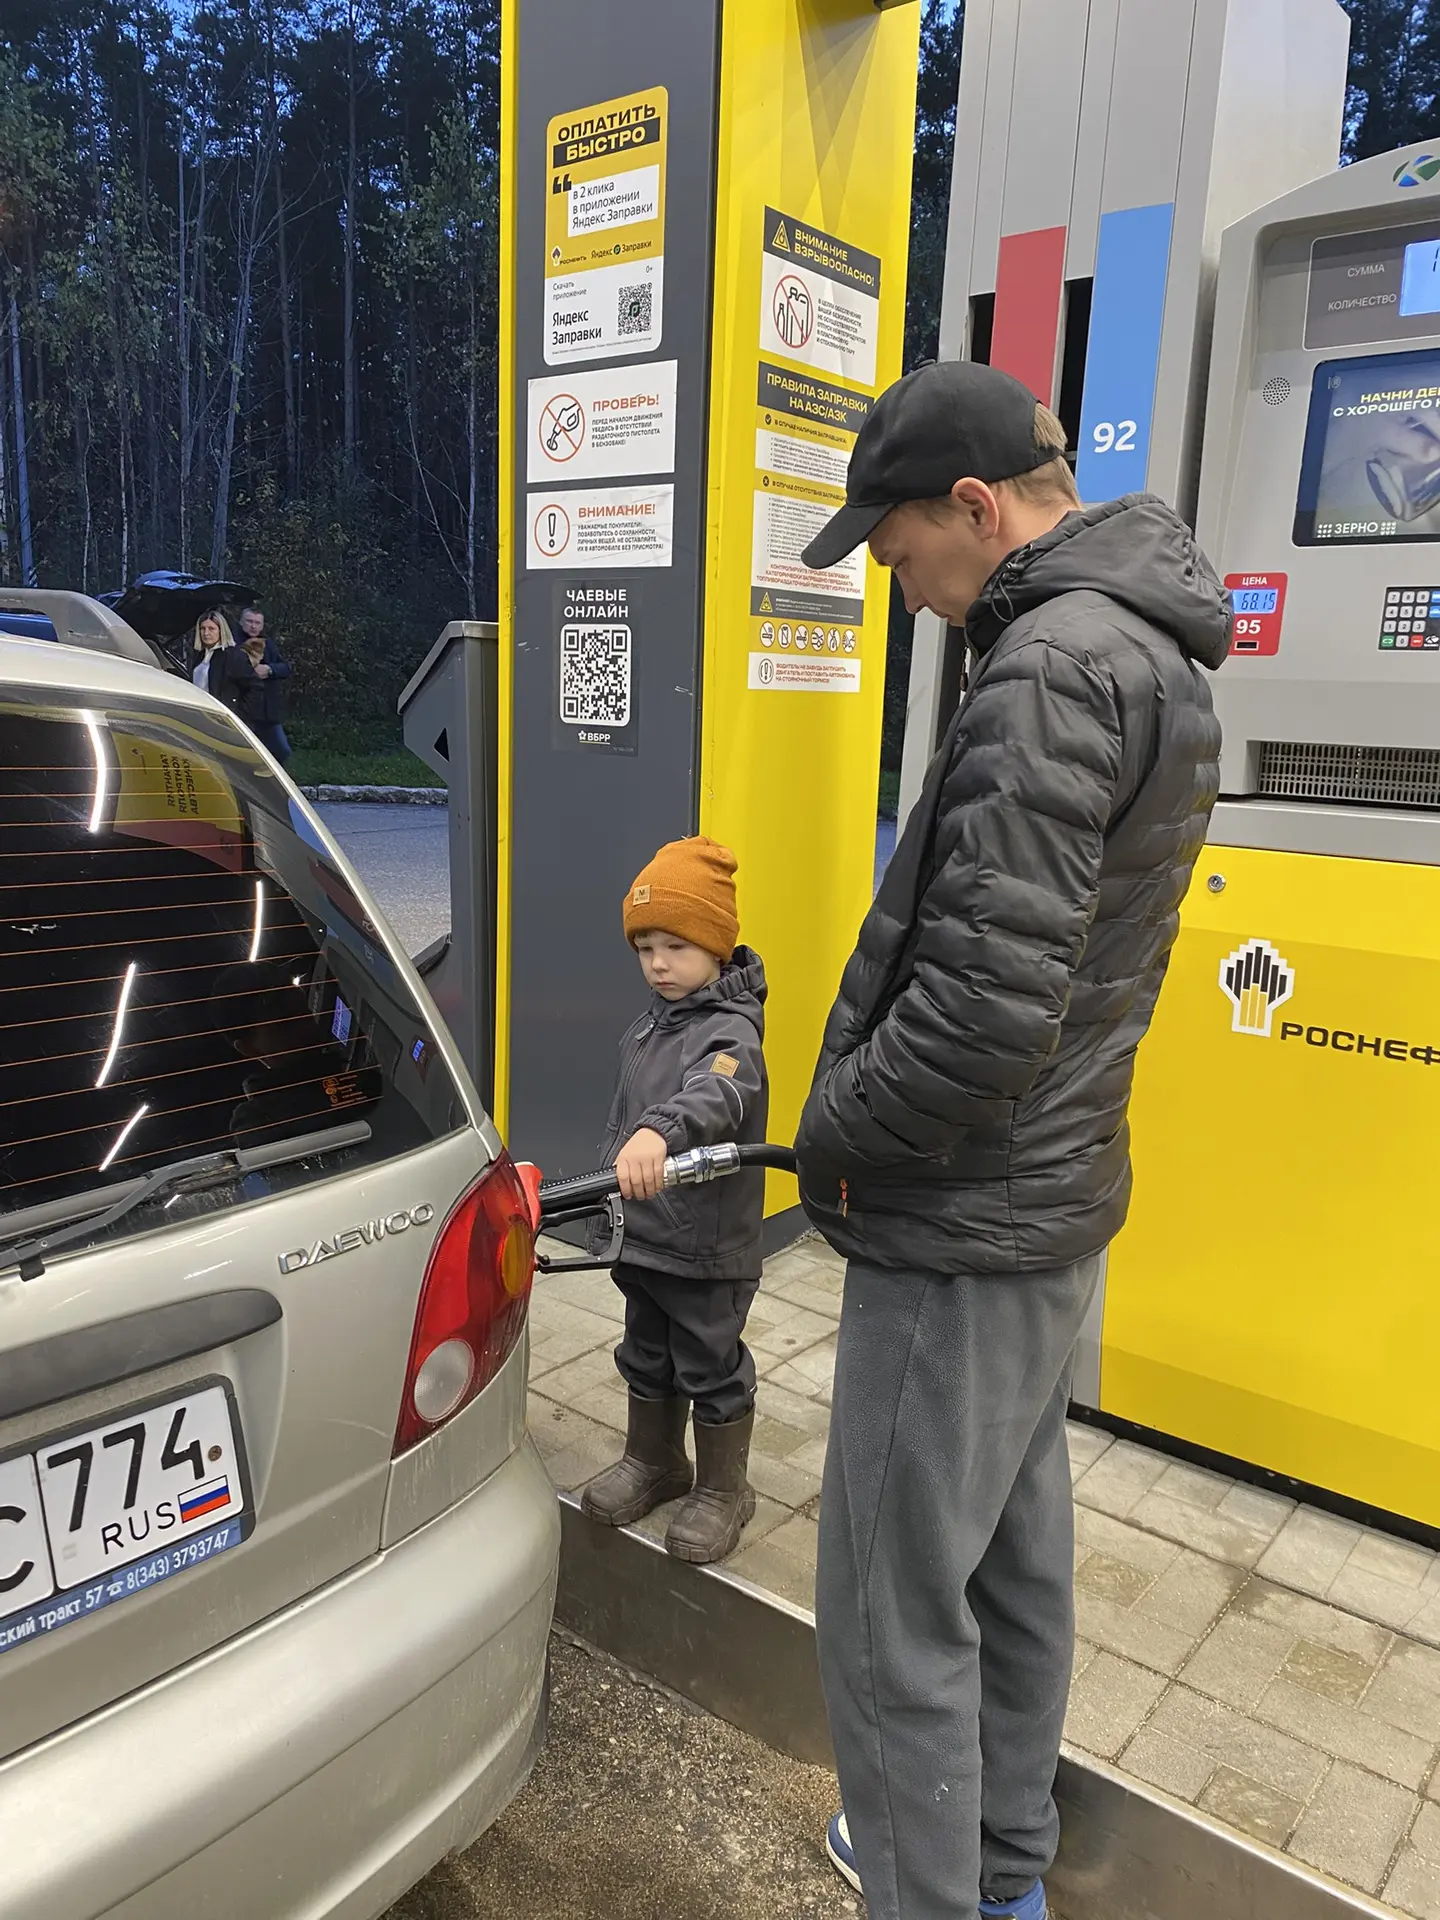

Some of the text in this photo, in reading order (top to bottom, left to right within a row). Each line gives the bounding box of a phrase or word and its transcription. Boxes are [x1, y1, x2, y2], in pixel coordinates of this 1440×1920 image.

[558, 104, 656, 142] ОПЛАТИТЬ
[566, 126, 646, 161] БЫСТРО
[573, 181, 615, 200] в 2 клика
[573, 189, 640, 215] в приложении
[572, 202, 653, 229] Яндекс Заправки
[591, 240, 652, 259] Яндекс Заправки
[795, 228, 848, 262] ВНИМАНИЕ
[794, 243, 875, 287] ВЗРЫВООПАСНО!
[1347, 264, 1385, 278] СУММА
[552, 282, 575, 291] Скачать
[552, 288, 587, 301] приложение
[1328, 293, 1397, 311] КОЛИЧЕСТВО
[552, 310, 589, 327] Яндекс
[552, 327, 602, 345] Заправки
[767, 373, 868, 414] ПРАВИЛА ЗАПРАВКИ
[1361, 386, 1440, 403] НАЧНИ ДЕ
[593, 394, 659, 412] ПРОВЕРЬ!
[789, 397, 848, 423] НА АЗС/АЗК
[1333, 407, 1344, 417] С
[1347, 399, 1432, 416] ХОРОШЕГО
[609, 415, 633, 424] НАЧАЛОМ
[633, 412, 663, 422] ДВИЖЕНИЯ
[620, 421, 652, 430] ОТСУТСТВИИ
[592, 428, 661, 440] РАЗДАТОЧНОГО ПИСТОЛЕТА
[1093, 420, 1137, 453] 92
[578, 503, 656, 518] ВНИМАНИЕ!
[1334, 521, 1379, 534] ЗЕРНО
[1242, 576, 1267, 586] ЦЕНА
[566, 589, 627, 602] ЧАЕВЫЕ
[564, 603, 629, 618] ОНЛАЙН
[1236, 619, 1261, 635] 95
[587, 732, 611, 742] ВБРР
[1280, 1021, 1440, 1066] РОСНЕФ
[278, 1202, 435, 1275] DAEWOO
[47, 1407, 205, 1532] 774
[101, 1501, 176, 1555] RUS
[38, 1598, 82, 1630] тракт
[85, 1584, 104, 1608] 57
[126, 1554, 170, 1590] 8(343)
[173, 1528, 229, 1569] 3793747
